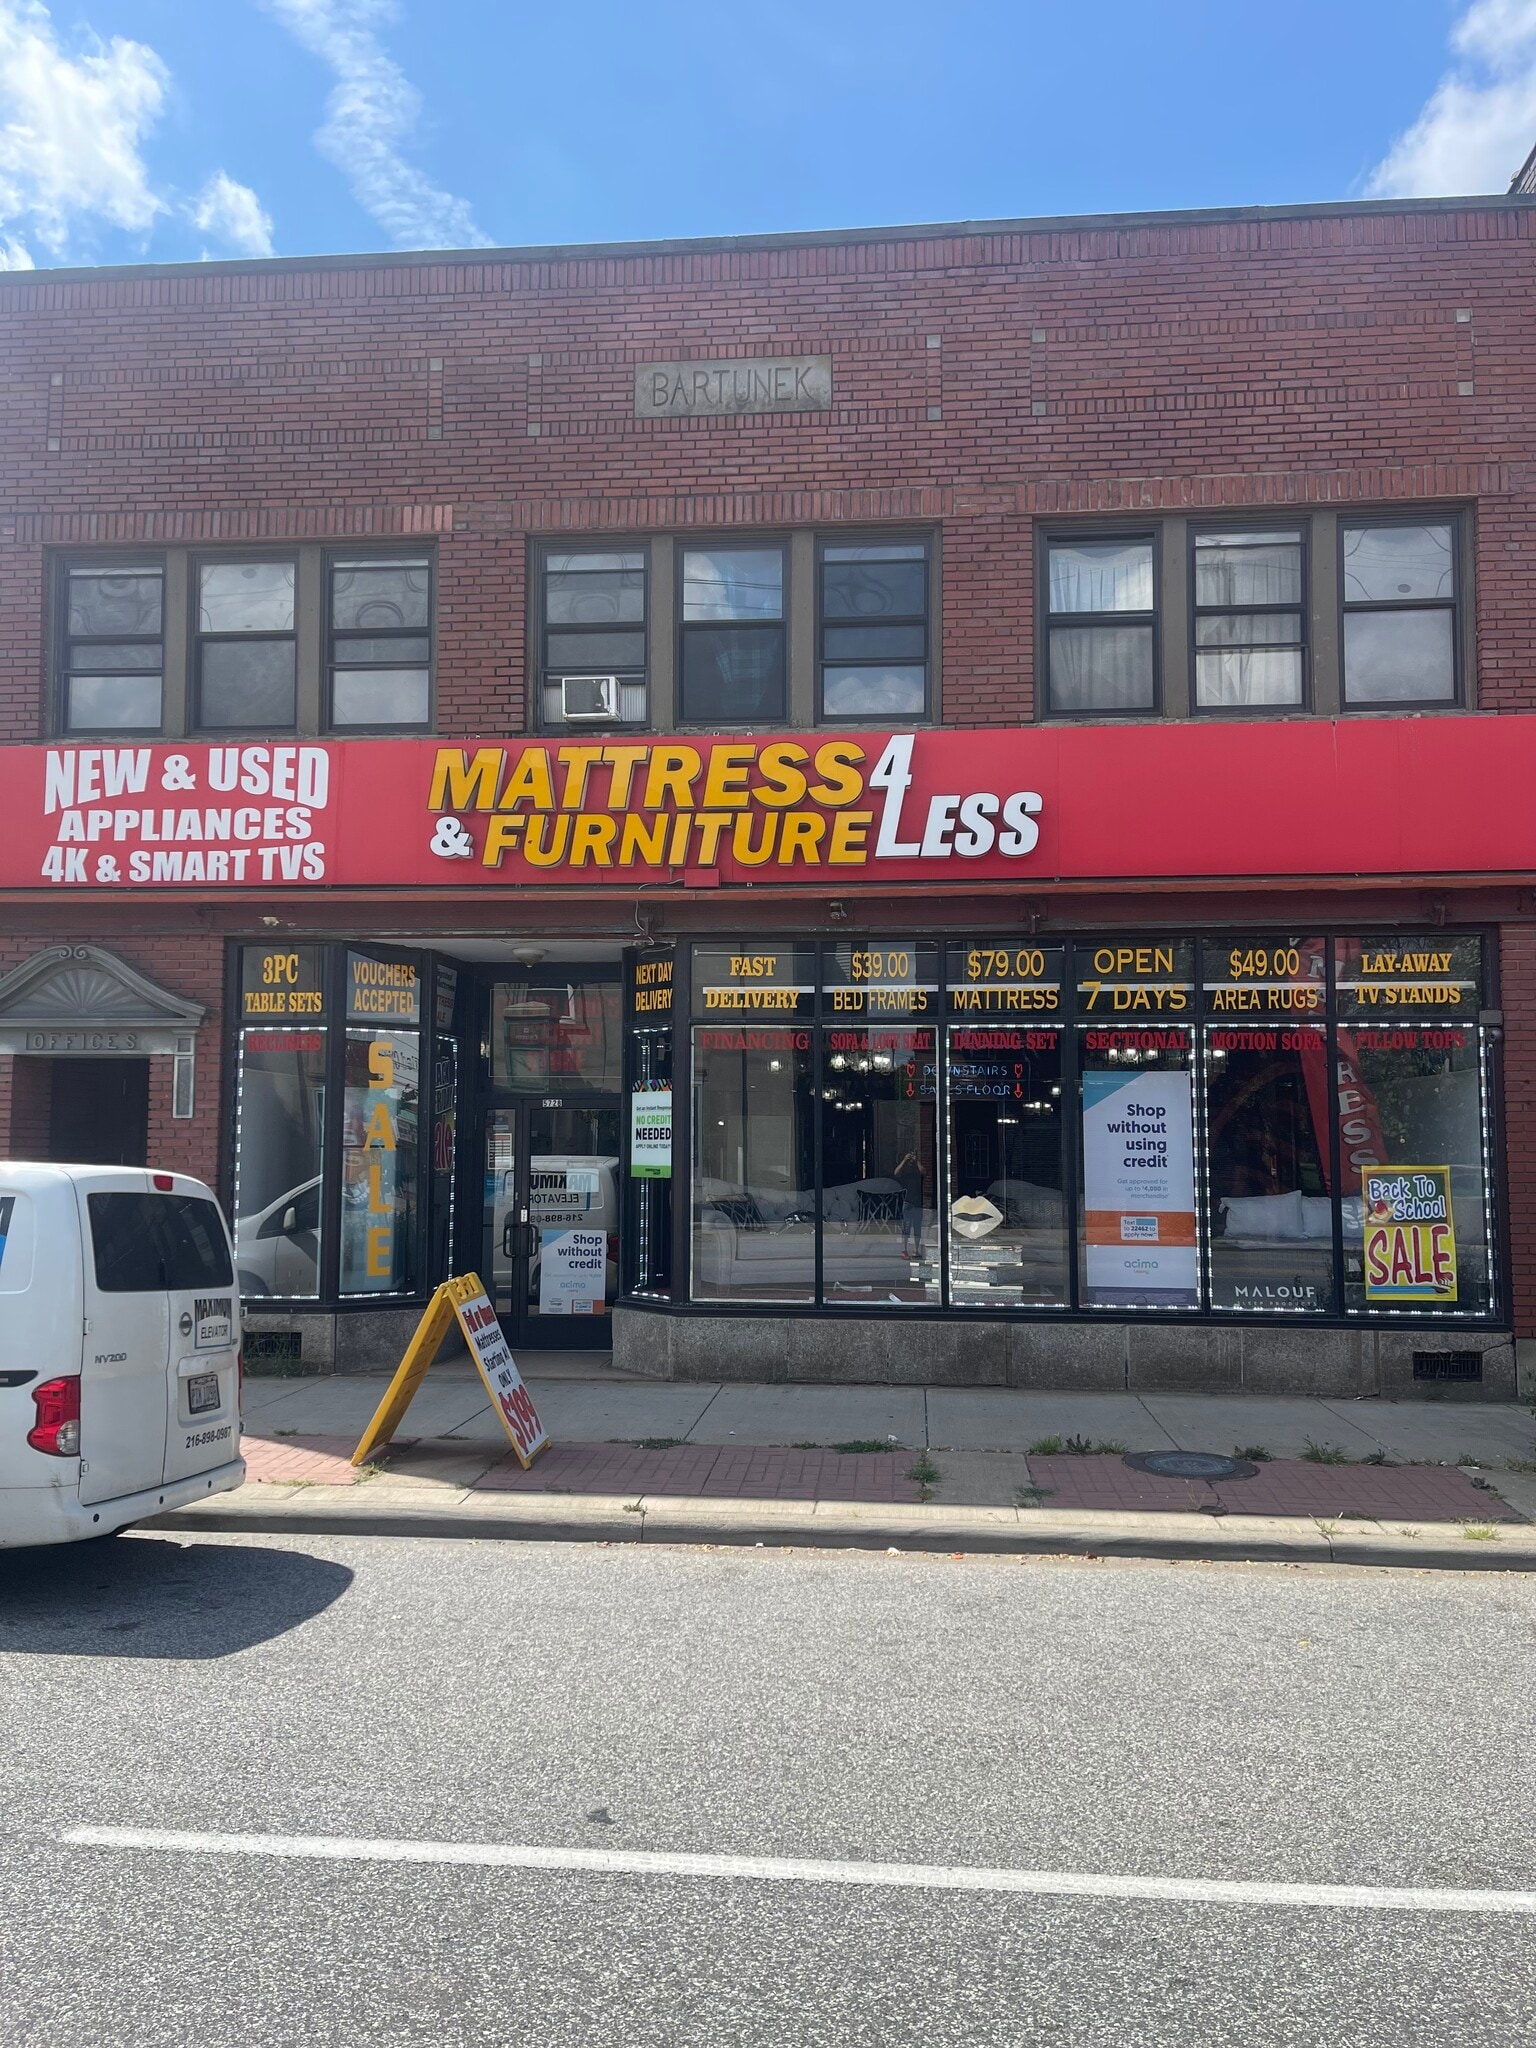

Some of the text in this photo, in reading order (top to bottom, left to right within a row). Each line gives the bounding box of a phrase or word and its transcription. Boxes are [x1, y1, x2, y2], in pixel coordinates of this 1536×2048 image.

[652, 366, 815, 407] BARTUNEK
[44, 746, 330, 815] NEW & USED
[426, 733, 916, 812] MATTRESS 4
[57, 806, 312, 842] APPLIANCES
[430, 816, 473, 859] &
[482, 810, 873, 868] FURNITURE
[41, 841, 326, 883] 4K & SMART TVS
[262, 953, 299, 984] 3PC
[729, 956, 776, 977] FAST
[852, 950, 909, 981] $39.00
[967, 949, 1045, 981] $79.00
[1093, 948, 1174, 974] OPEN
[1229, 948, 1300, 980] $49.00
[1361, 953, 1453, 973] LAY-AWAY
[353, 961, 416, 988] VOUCHERS
[635, 961, 674, 985] NEXT DAY
[245, 991, 323, 1013] TABLE SETS
[354, 988, 414, 1014] ACCEPTED
[635, 988, 673, 1012] DELIVERY
[705, 989, 800, 1009] DELIVERY
[833, 988, 928, 1011] BED FRAMES
[953, 987, 1059, 1010] MATTRESS
[1082, 981, 1187, 1010] 7 DAYS
[1213, 985, 1319, 1011] AREA RUGS
[1355, 984, 1462, 1005] TV STANDS
[33, 1032, 139, 1050] OFFICES
[247, 1034, 322, 1052] RECLINERS
[701, 1032, 810, 1050] FINANCING
[831, 1032, 860, 1050] SOFA
[860, 1033, 869, 1050] &
[903, 1032, 931, 1050] SEAT
[1026, 1032, 1058, 1050] SET
[1085, 1031, 1190, 1050] SECTIONAL
[1212, 1032, 1323, 1050] MOTION SOFA
[1356, 1031, 1466, 1050] PILLOW TOPS
[923, 1064, 1008, 1076] DONSTAIRS
[966, 1084, 1011, 1096] FLOOR
[636, 1114, 671, 1125] NO CREDIT
[1127, 1103, 1166, 1119] Shop
[635, 1127, 671, 1141] NEEDED
[1107, 1120, 1167, 1134] without
[1126, 1137, 1167, 1153] using
[364, 1042, 396, 1277] SALE
[1369, 1175, 1435, 1200] Back To
[1394, 1195, 1446, 1220] School
[557, 1245, 603, 1257] without
[573, 1234, 603, 1247] Shop
[568, 1258, 603, 1269] credit
[1123, 1258, 1159, 1269] acima
[1368, 1225, 1454, 1286] SALE
[560, 1280, 586, 1289] acima
[1234, 1285, 1316, 1298] MALOUF
[200, 1325, 228, 1339] ELEVATOR
[474, 1329, 501, 1351] Mattresses
[94, 1352, 127, 1364] NV200
[484, 1352, 506, 1372] Starting
[498, 1374, 513, 1388] ONLY
[497, 1384, 543, 1455] $199
[186, 1426, 232, 1449] 216-898-0987
